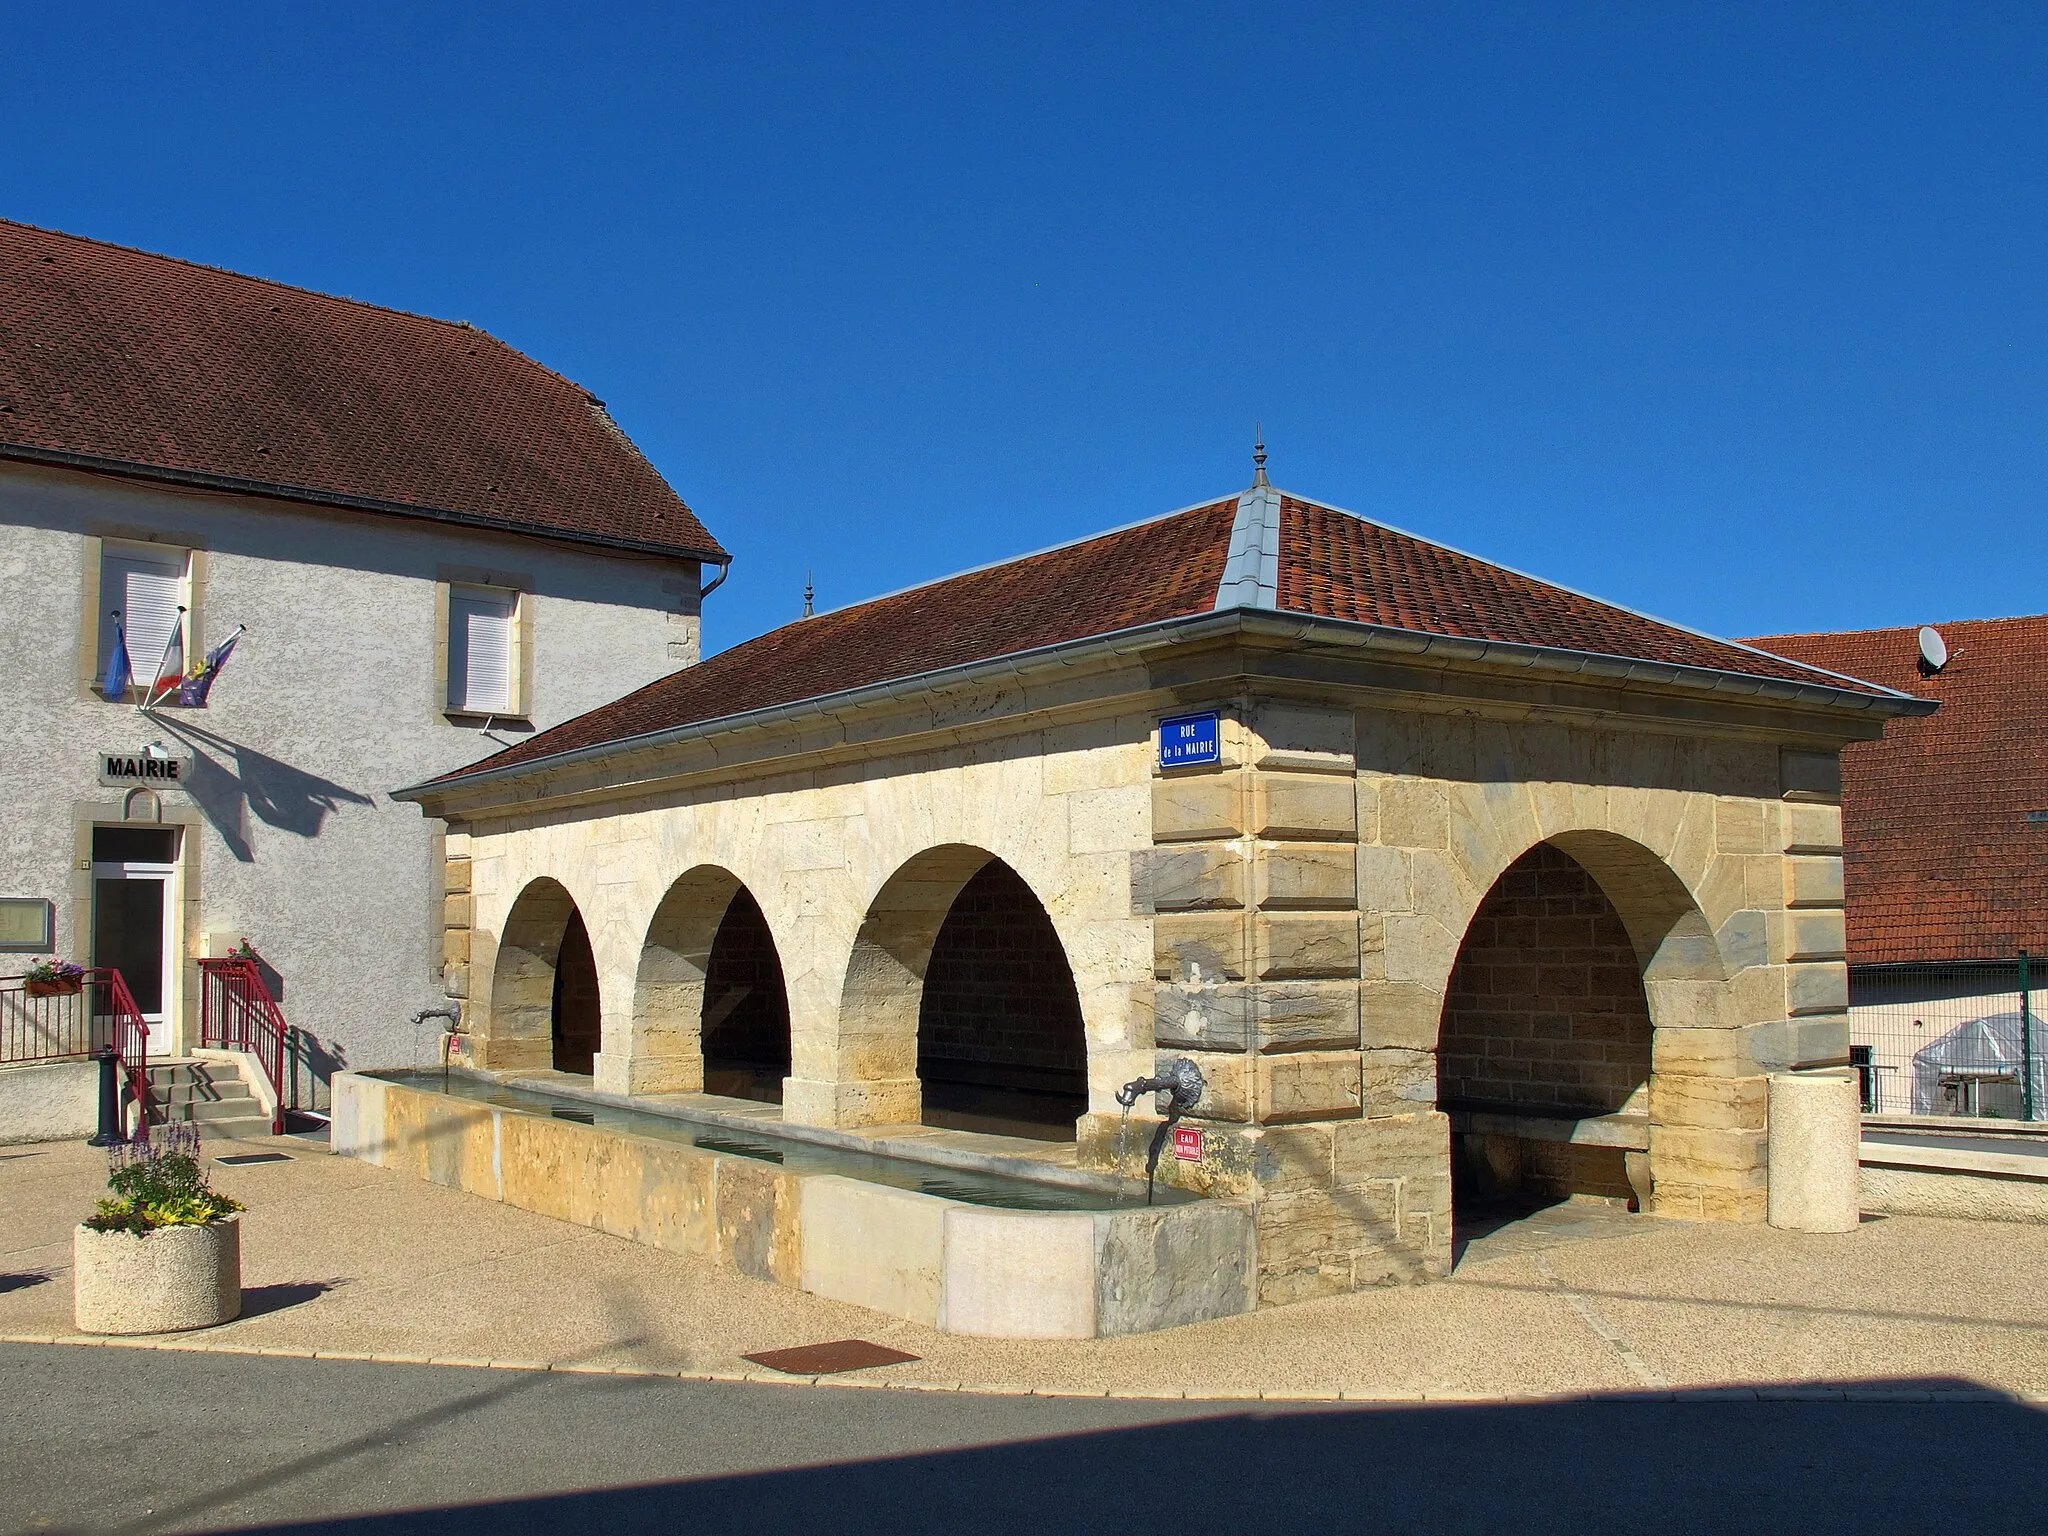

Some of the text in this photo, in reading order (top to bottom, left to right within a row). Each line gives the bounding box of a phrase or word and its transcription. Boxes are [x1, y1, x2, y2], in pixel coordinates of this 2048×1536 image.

[1181, 724, 1195, 738] RUE
[1163, 740, 1213, 758] de la MAIRIE
[107, 757, 178, 779] MAIRIE
[1181, 1134, 1194, 1144] EAU
